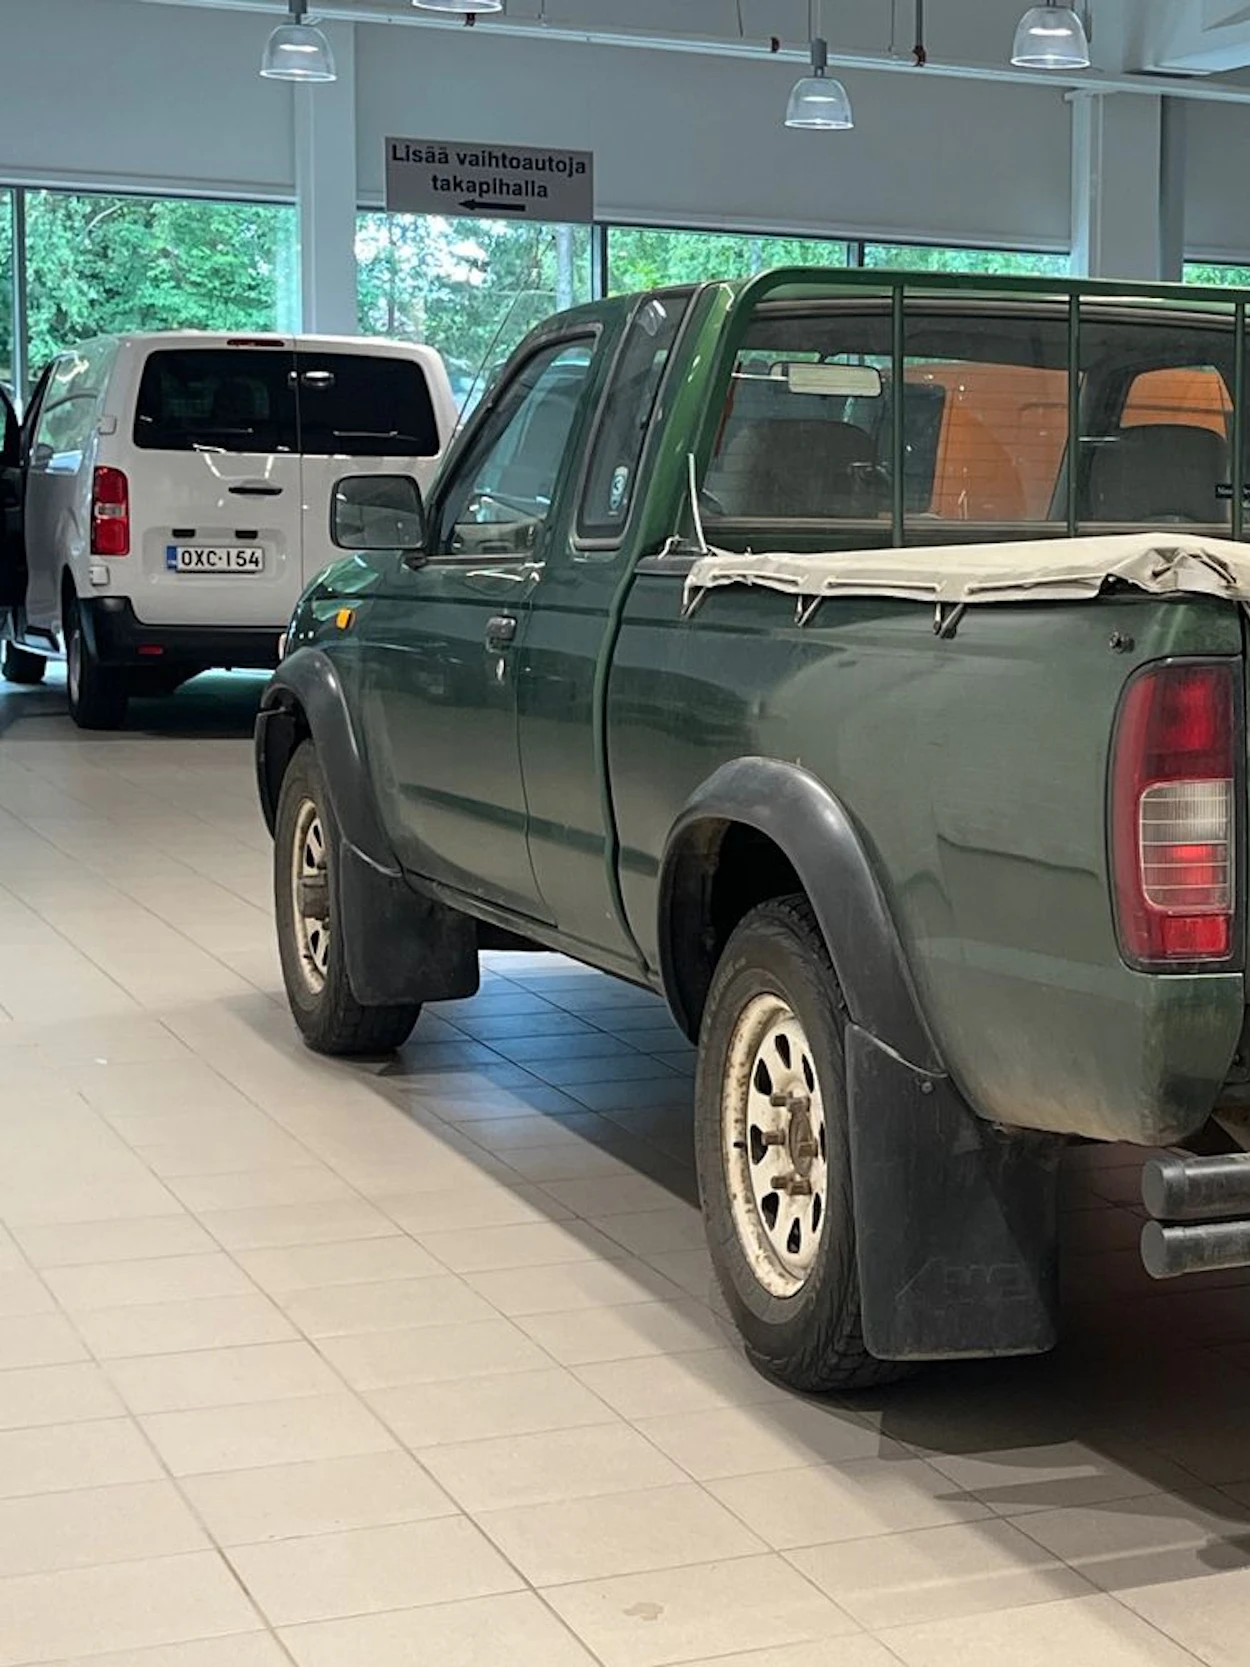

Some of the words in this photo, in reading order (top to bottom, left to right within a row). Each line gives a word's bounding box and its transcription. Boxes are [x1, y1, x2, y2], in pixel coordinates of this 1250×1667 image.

[391, 144, 449, 165] Lisää
[456, 150, 586, 178] vaihtoautoja
[431, 174, 548, 198] takapihalla
